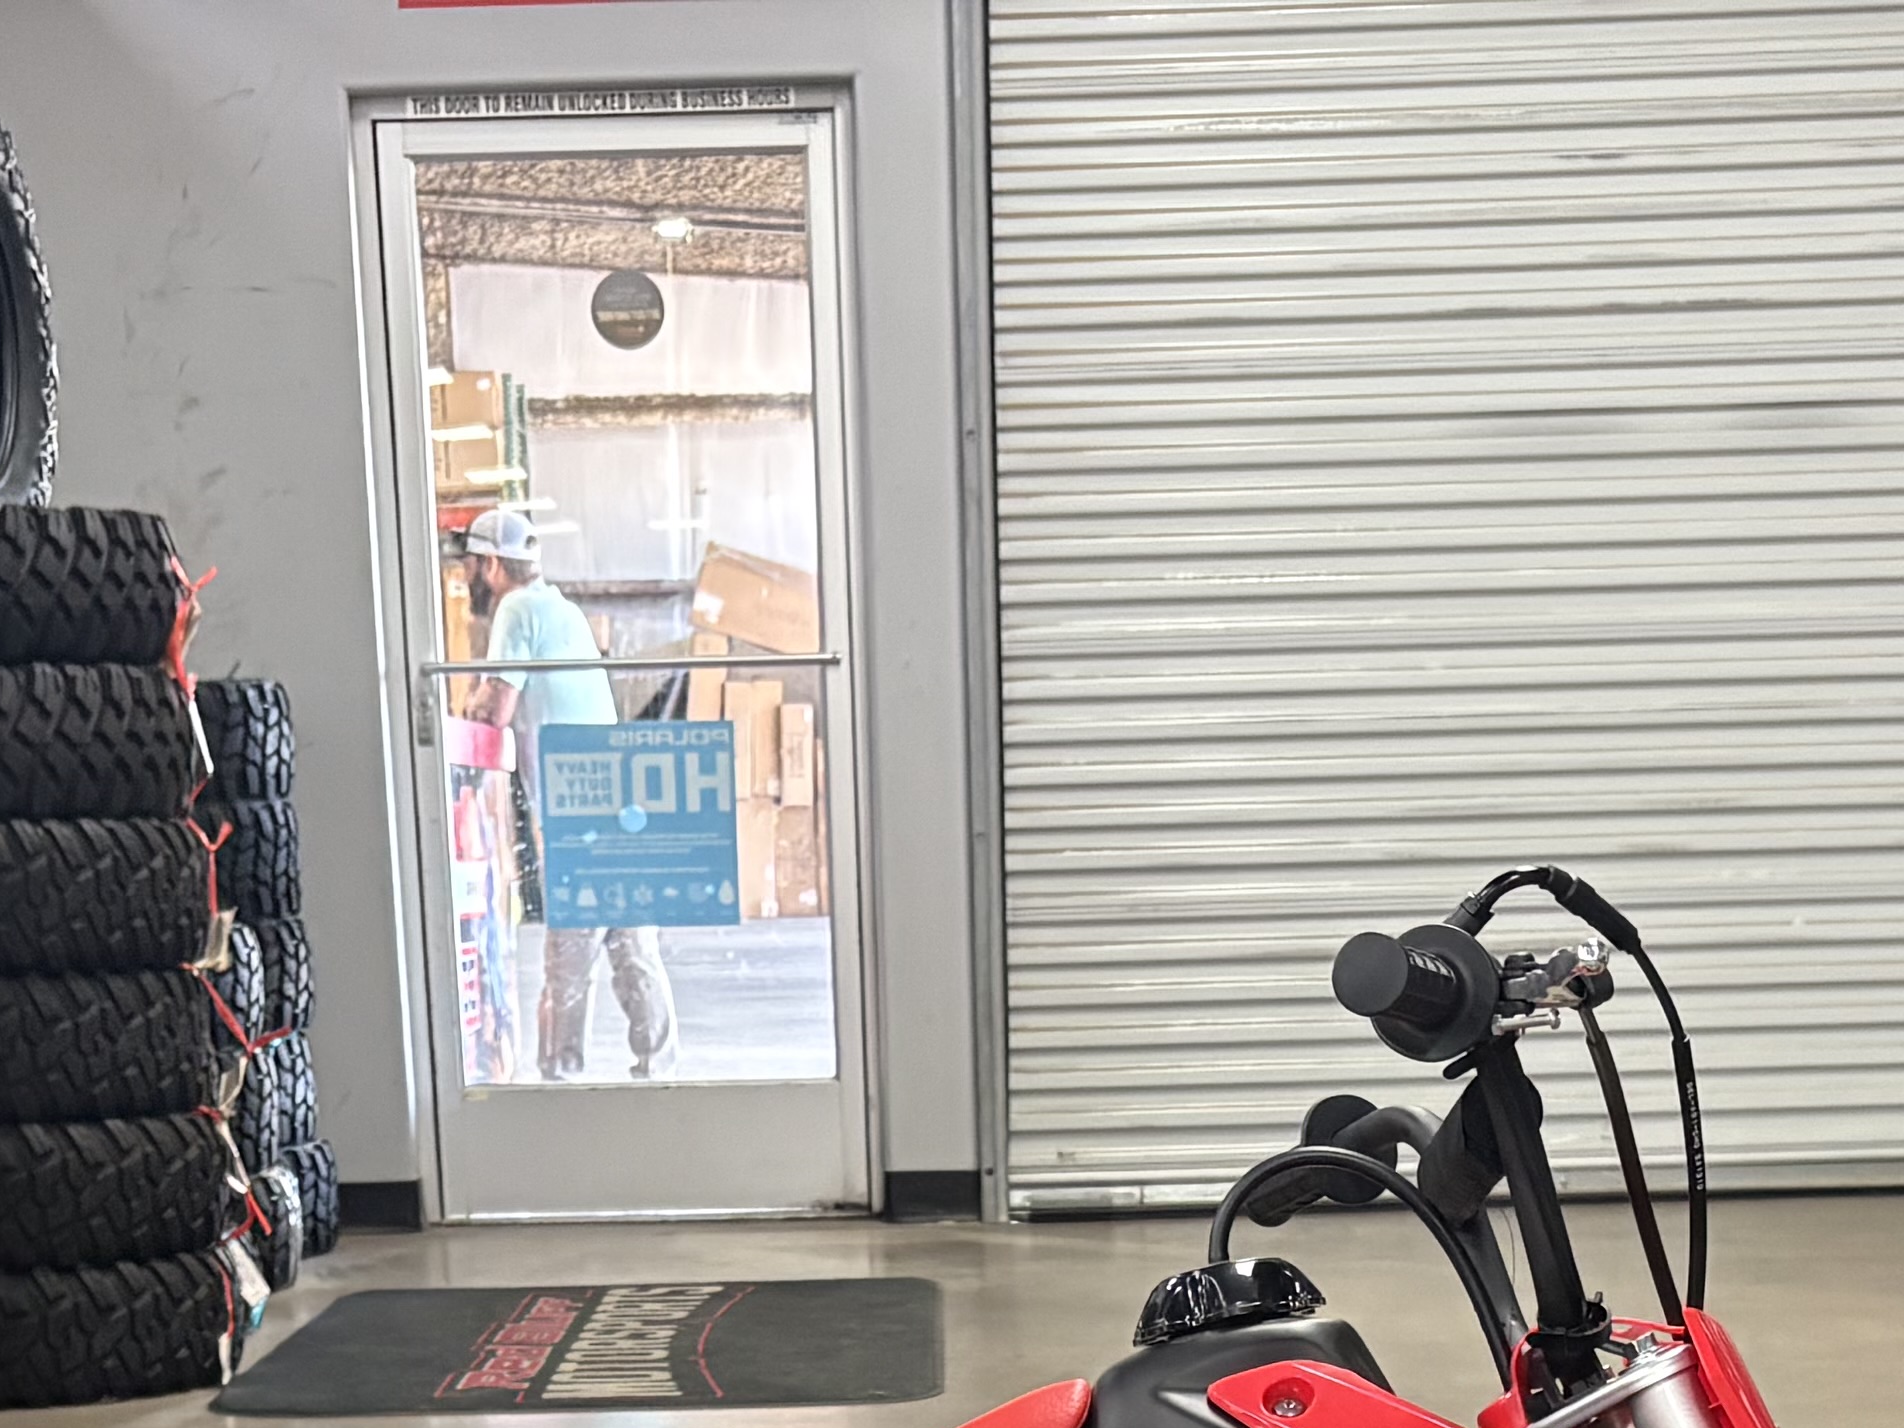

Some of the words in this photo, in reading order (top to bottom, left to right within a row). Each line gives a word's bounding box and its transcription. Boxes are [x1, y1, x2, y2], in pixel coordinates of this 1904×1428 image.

[412, 96, 440, 114] THIS
[445, 95, 481, 114] DOOR
[484, 95, 500, 113] TO
[504, 93, 555, 112] REMAIN
[558, 92, 627, 111] UNLOCKED
[630, 91, 678, 109] DURING
[681, 89, 744, 108] BUSINESS
[748, 87, 790, 106] HOURS
[541, 1285, 725, 1399] MOTORSPORTS
